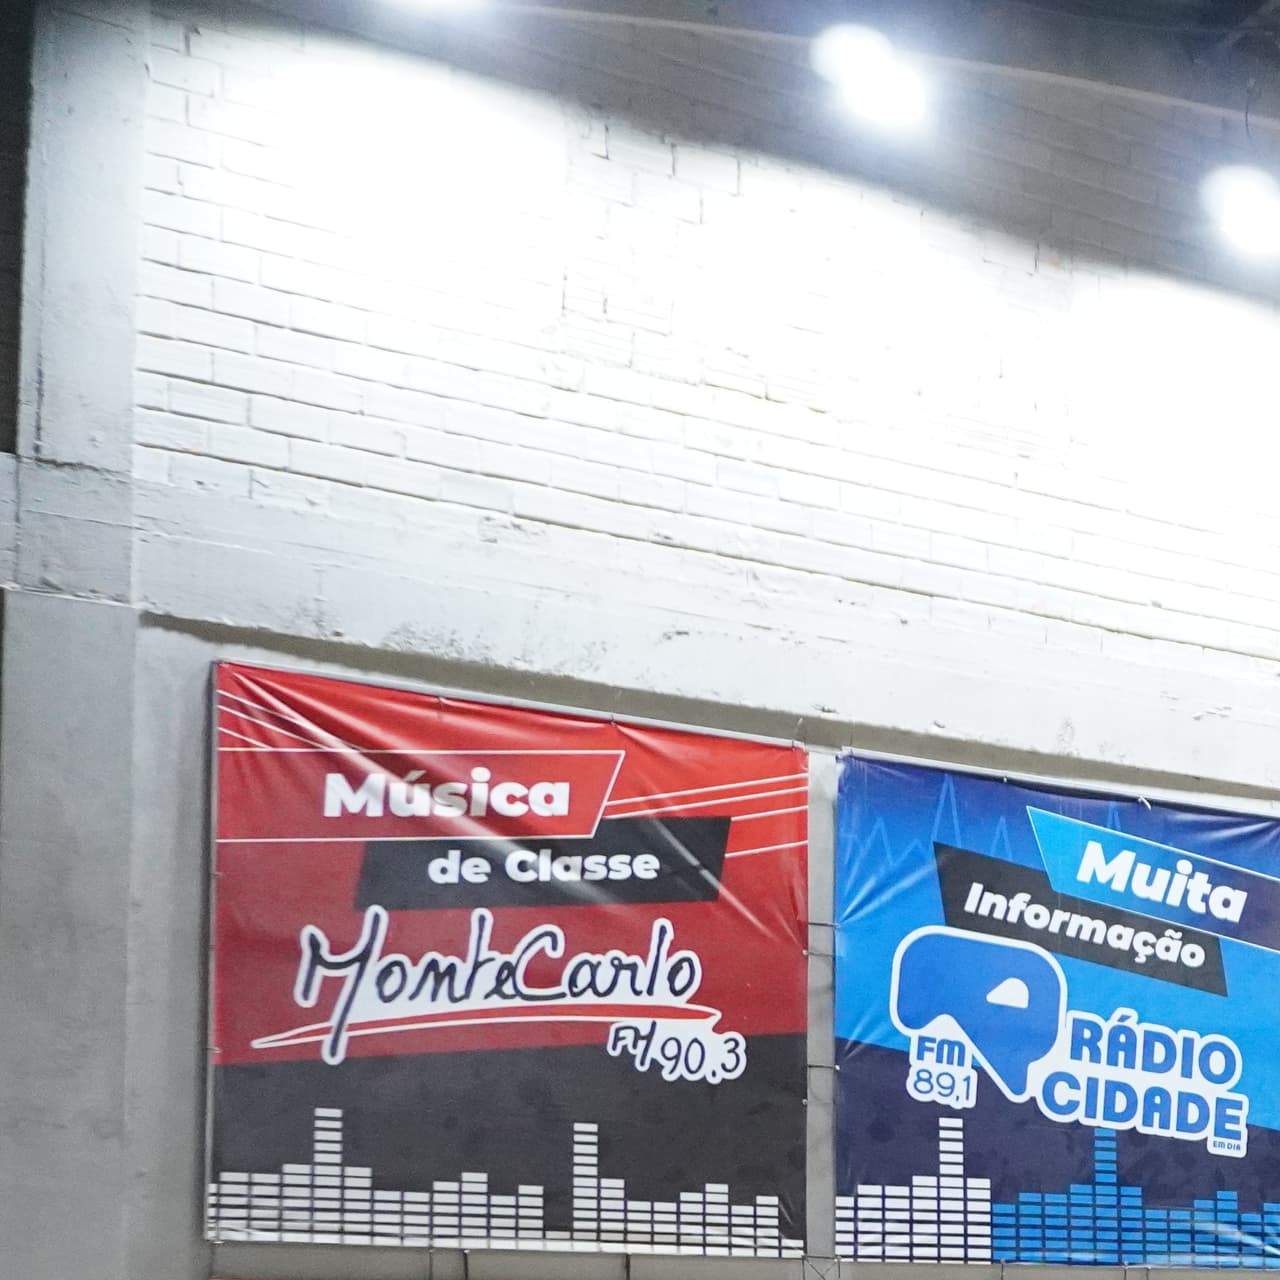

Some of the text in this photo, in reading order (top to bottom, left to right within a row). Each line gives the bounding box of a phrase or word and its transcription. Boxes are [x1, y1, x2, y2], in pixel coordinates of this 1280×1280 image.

[324, 767, 571, 819] Música
[428, 848, 660, 885] de Classe
[1076, 840, 1248, 924] Muita
[964, 882, 1206, 968] Informação
[659, 1034, 745, 1083] 90.3
[915, 1034, 966, 1068] FM
[1068, 1012, 1238, 1087] RÁDIO
[912, 1069, 973, 1103] 89,1
[1042, 1070, 1244, 1142] CIDADE
[1213, 1140, 1242, 1152] EM DIA
